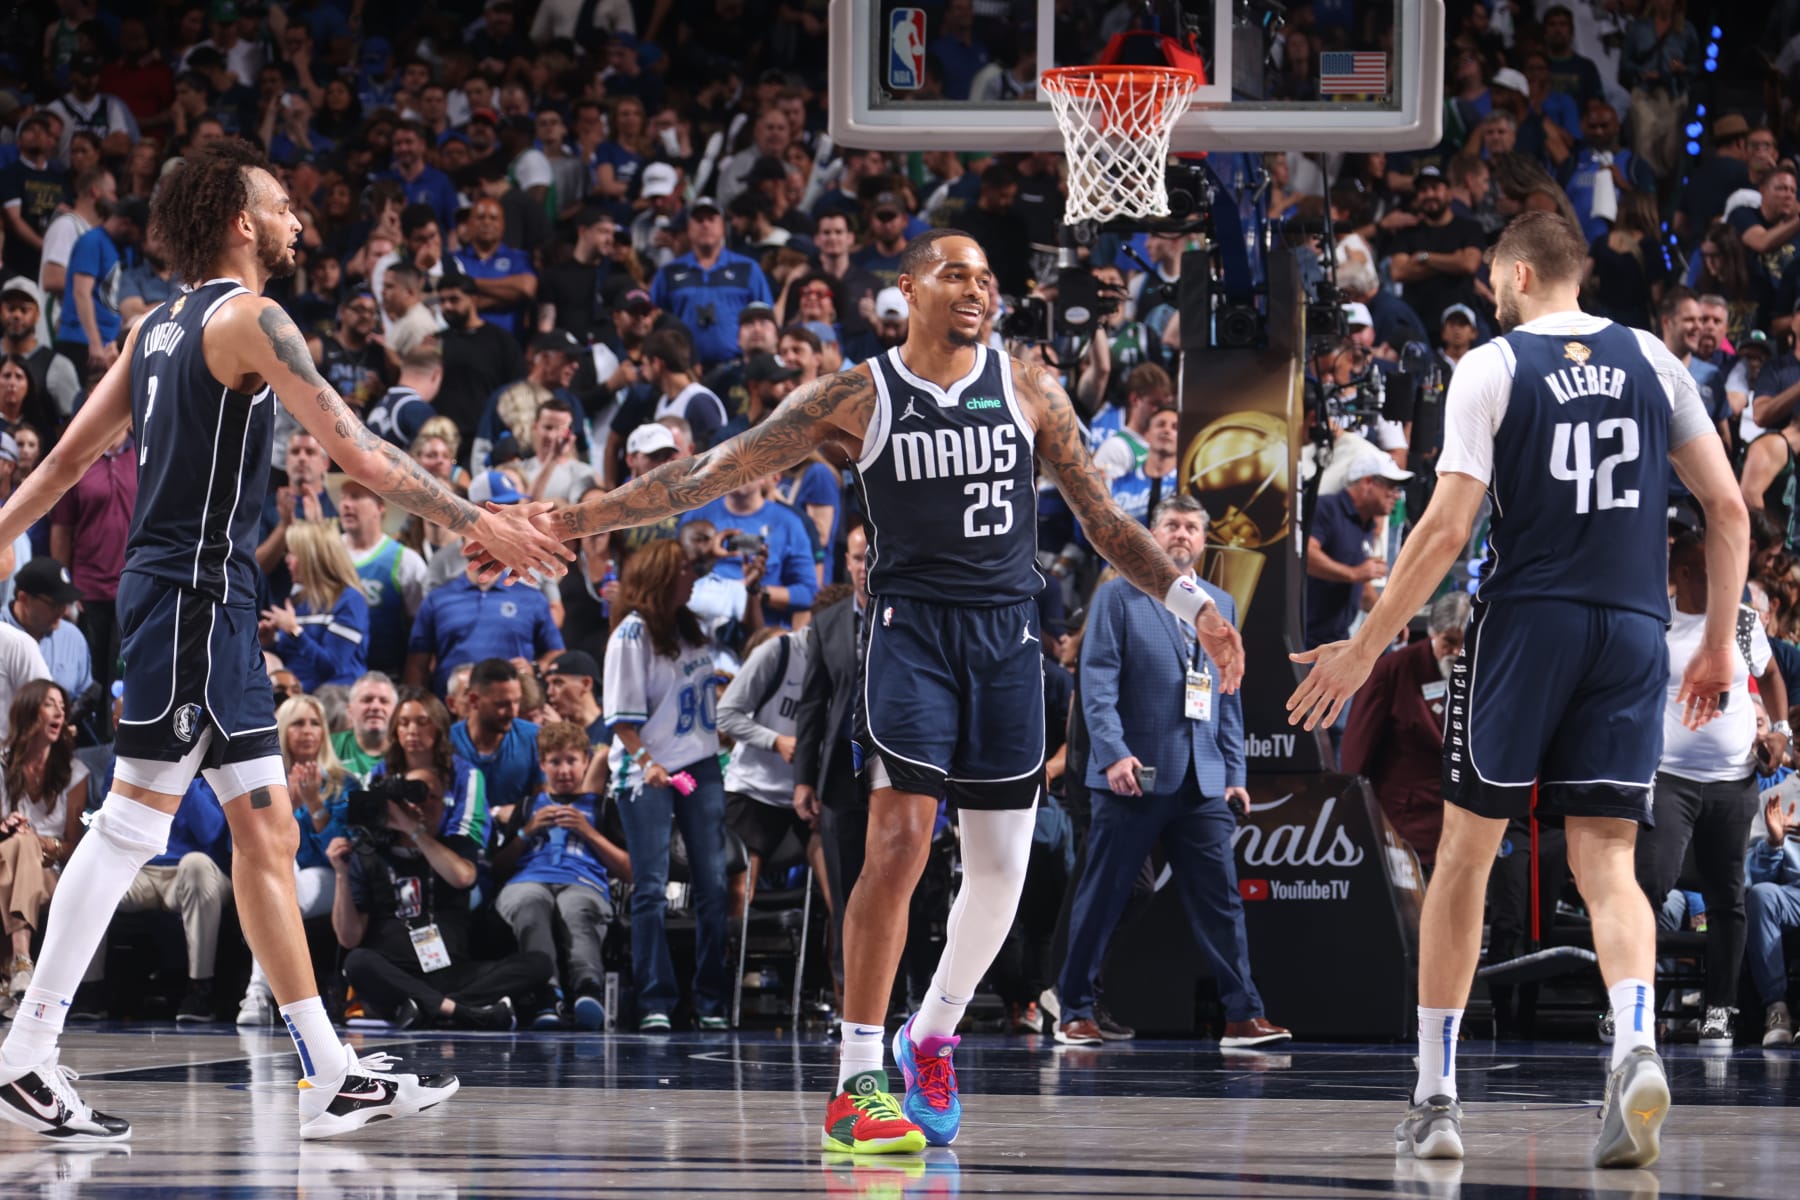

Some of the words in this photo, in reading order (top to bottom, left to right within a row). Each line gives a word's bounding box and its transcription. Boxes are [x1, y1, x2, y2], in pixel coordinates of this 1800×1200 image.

[966, 397, 1002, 409] chime
[1544, 364, 1626, 405] KLEBER
[891, 424, 1017, 481] MAVS
[1549, 417, 1640, 514] 42
[963, 479, 1014, 538] 25
[1270, 879, 1350, 900] YouTubeTV
